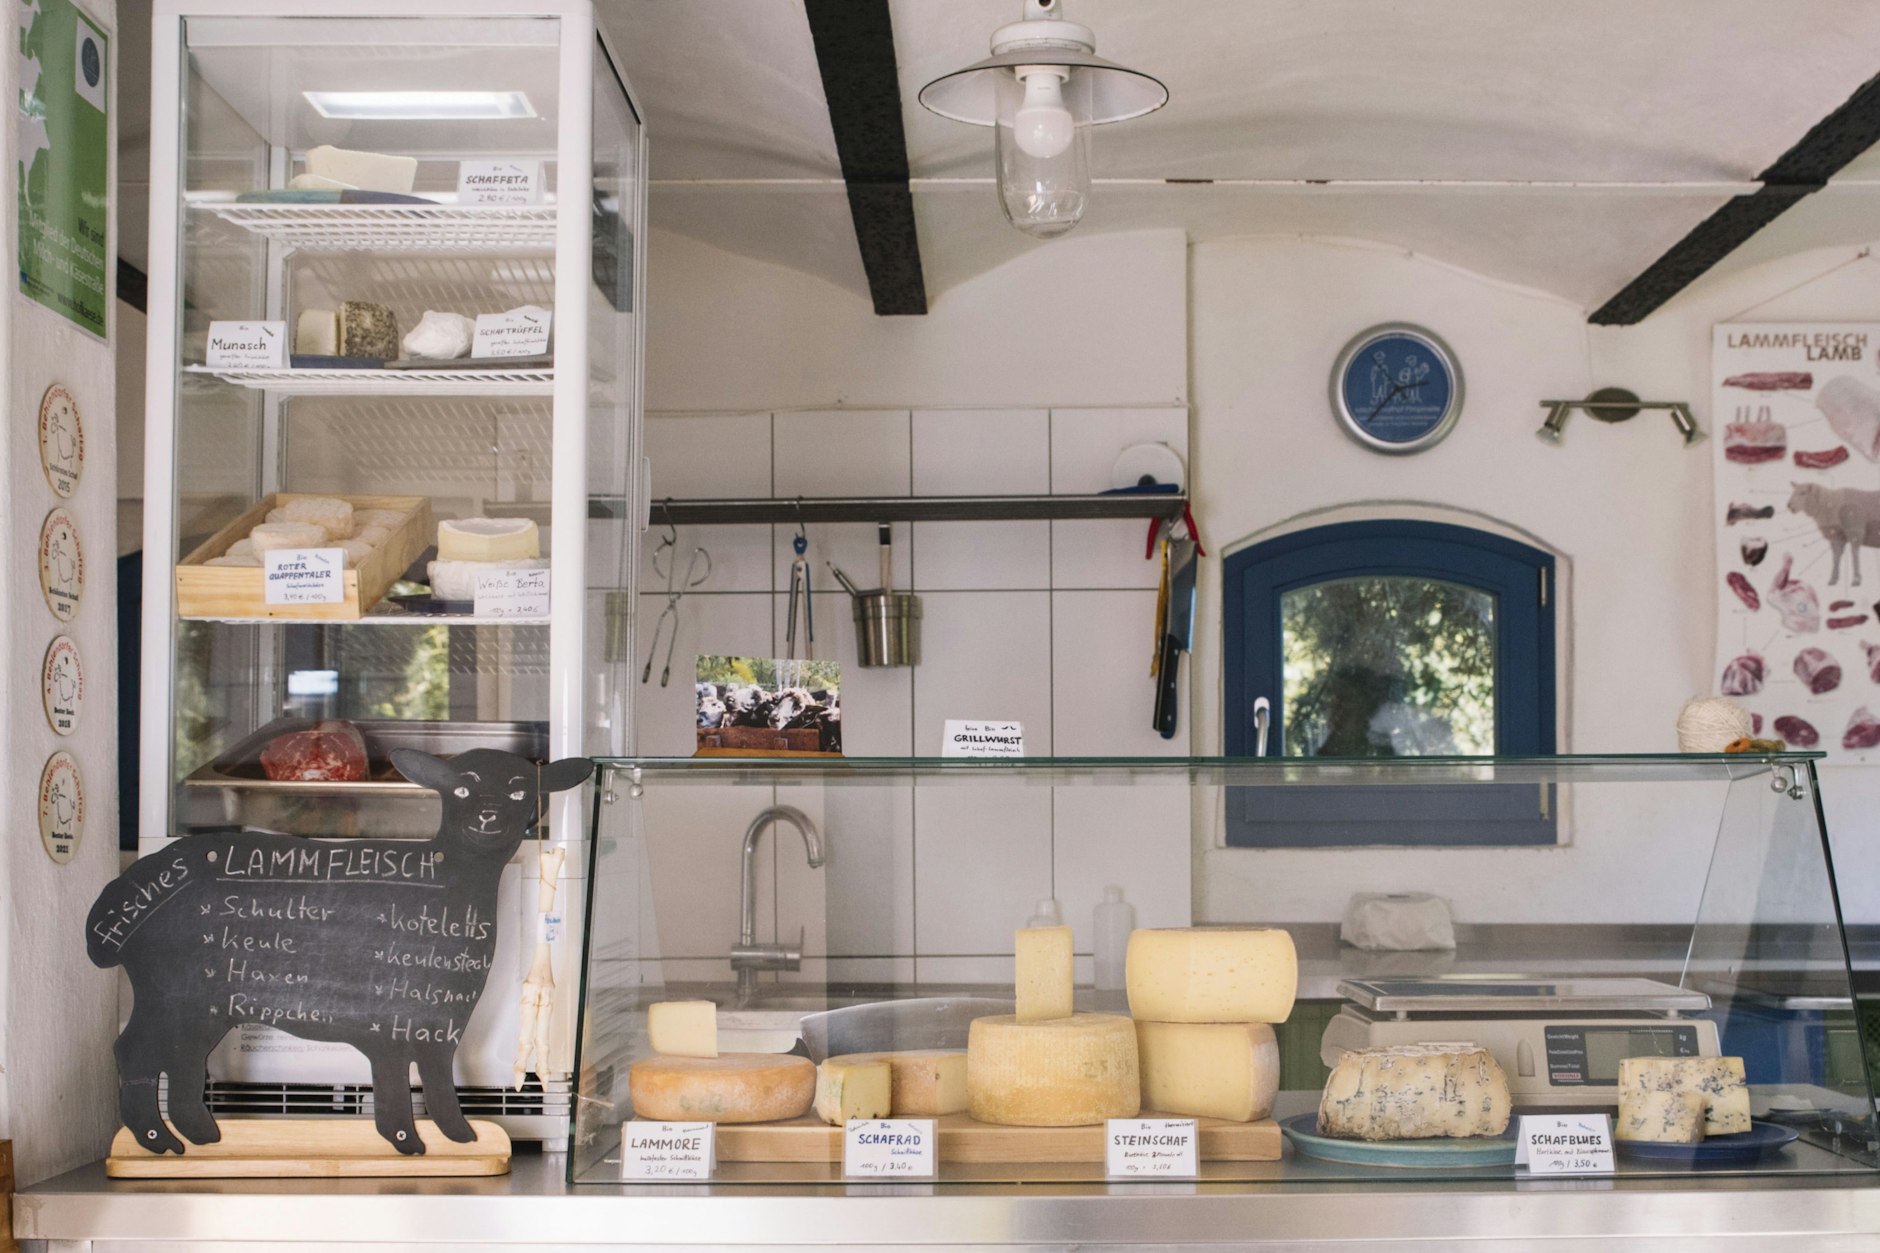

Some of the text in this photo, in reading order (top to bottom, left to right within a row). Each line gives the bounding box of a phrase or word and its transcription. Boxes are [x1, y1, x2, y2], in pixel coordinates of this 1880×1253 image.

[466, 175, 529, 184] SCHAFFETA
[480, 325, 544, 336] SCHAFTRÜFFEL
[211, 336, 267, 351] Munasch
[1727, 333, 1868, 348] LAMMFLEISCH
[1806, 345, 1863, 361] LAMB
[277, 563, 307, 571] ROTER
[269, 570, 331, 580] QUAPPENTALER
[478, 576, 545, 591] Weiße Berta
[954, 734, 1022, 745] GRILLWURST
[219, 895, 336, 921] Schulter
[227, 958, 309, 983] Haxen
[391, 1014, 461, 1045] Hack
[631, 1138, 701, 1150] LAMMORE
[858, 1134, 921, 1145] SCHAFRAD
[1114, 1135, 1188, 1146] STEINSCHAF
[1531, 1135, 1602, 1145] SCHAFBLUES
[1574, 1160, 1591, 1168] 3,50
